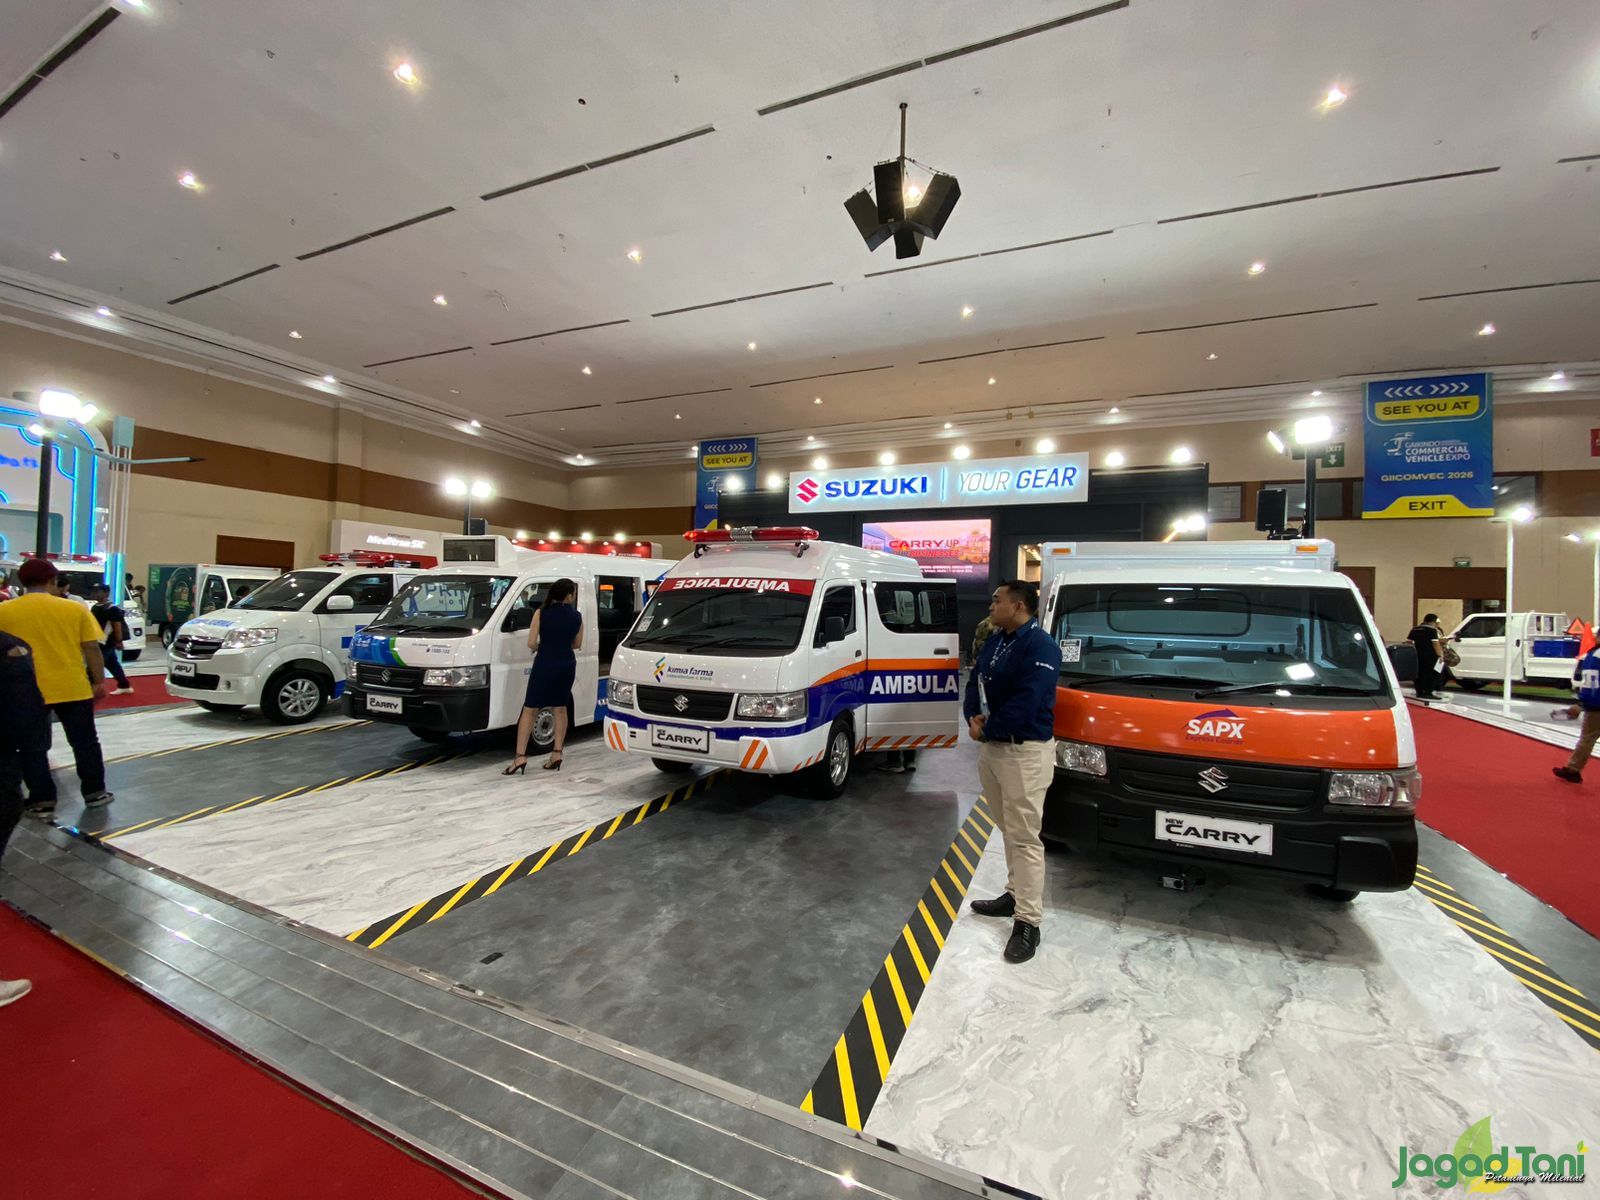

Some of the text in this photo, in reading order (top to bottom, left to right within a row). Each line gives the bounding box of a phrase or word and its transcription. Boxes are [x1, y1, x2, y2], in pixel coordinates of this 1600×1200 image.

[1382, 401, 1471, 416] SEE YOU AT
[1405, 445, 1469, 456] COMMERCIAL
[706, 455, 749, 465] SEE YOU AT
[1405, 453, 1471, 463] VEHICLE EXPO
[1447, 471, 1474, 479] 2026
[825, 466, 1078, 499] SUZUKI YOUR GEAR
[1408, 500, 1447, 511] EXIT
[889, 539, 960, 549] CARRY UP
[667, 665, 714, 677] kimia farma
[869, 675, 959, 695] AMBULA
[369, 700, 399, 710] CARRY
[1186, 719, 1246, 739] SAPX
[657, 732, 702, 746] CARRY
[1165, 824, 1262, 846] CARRY
